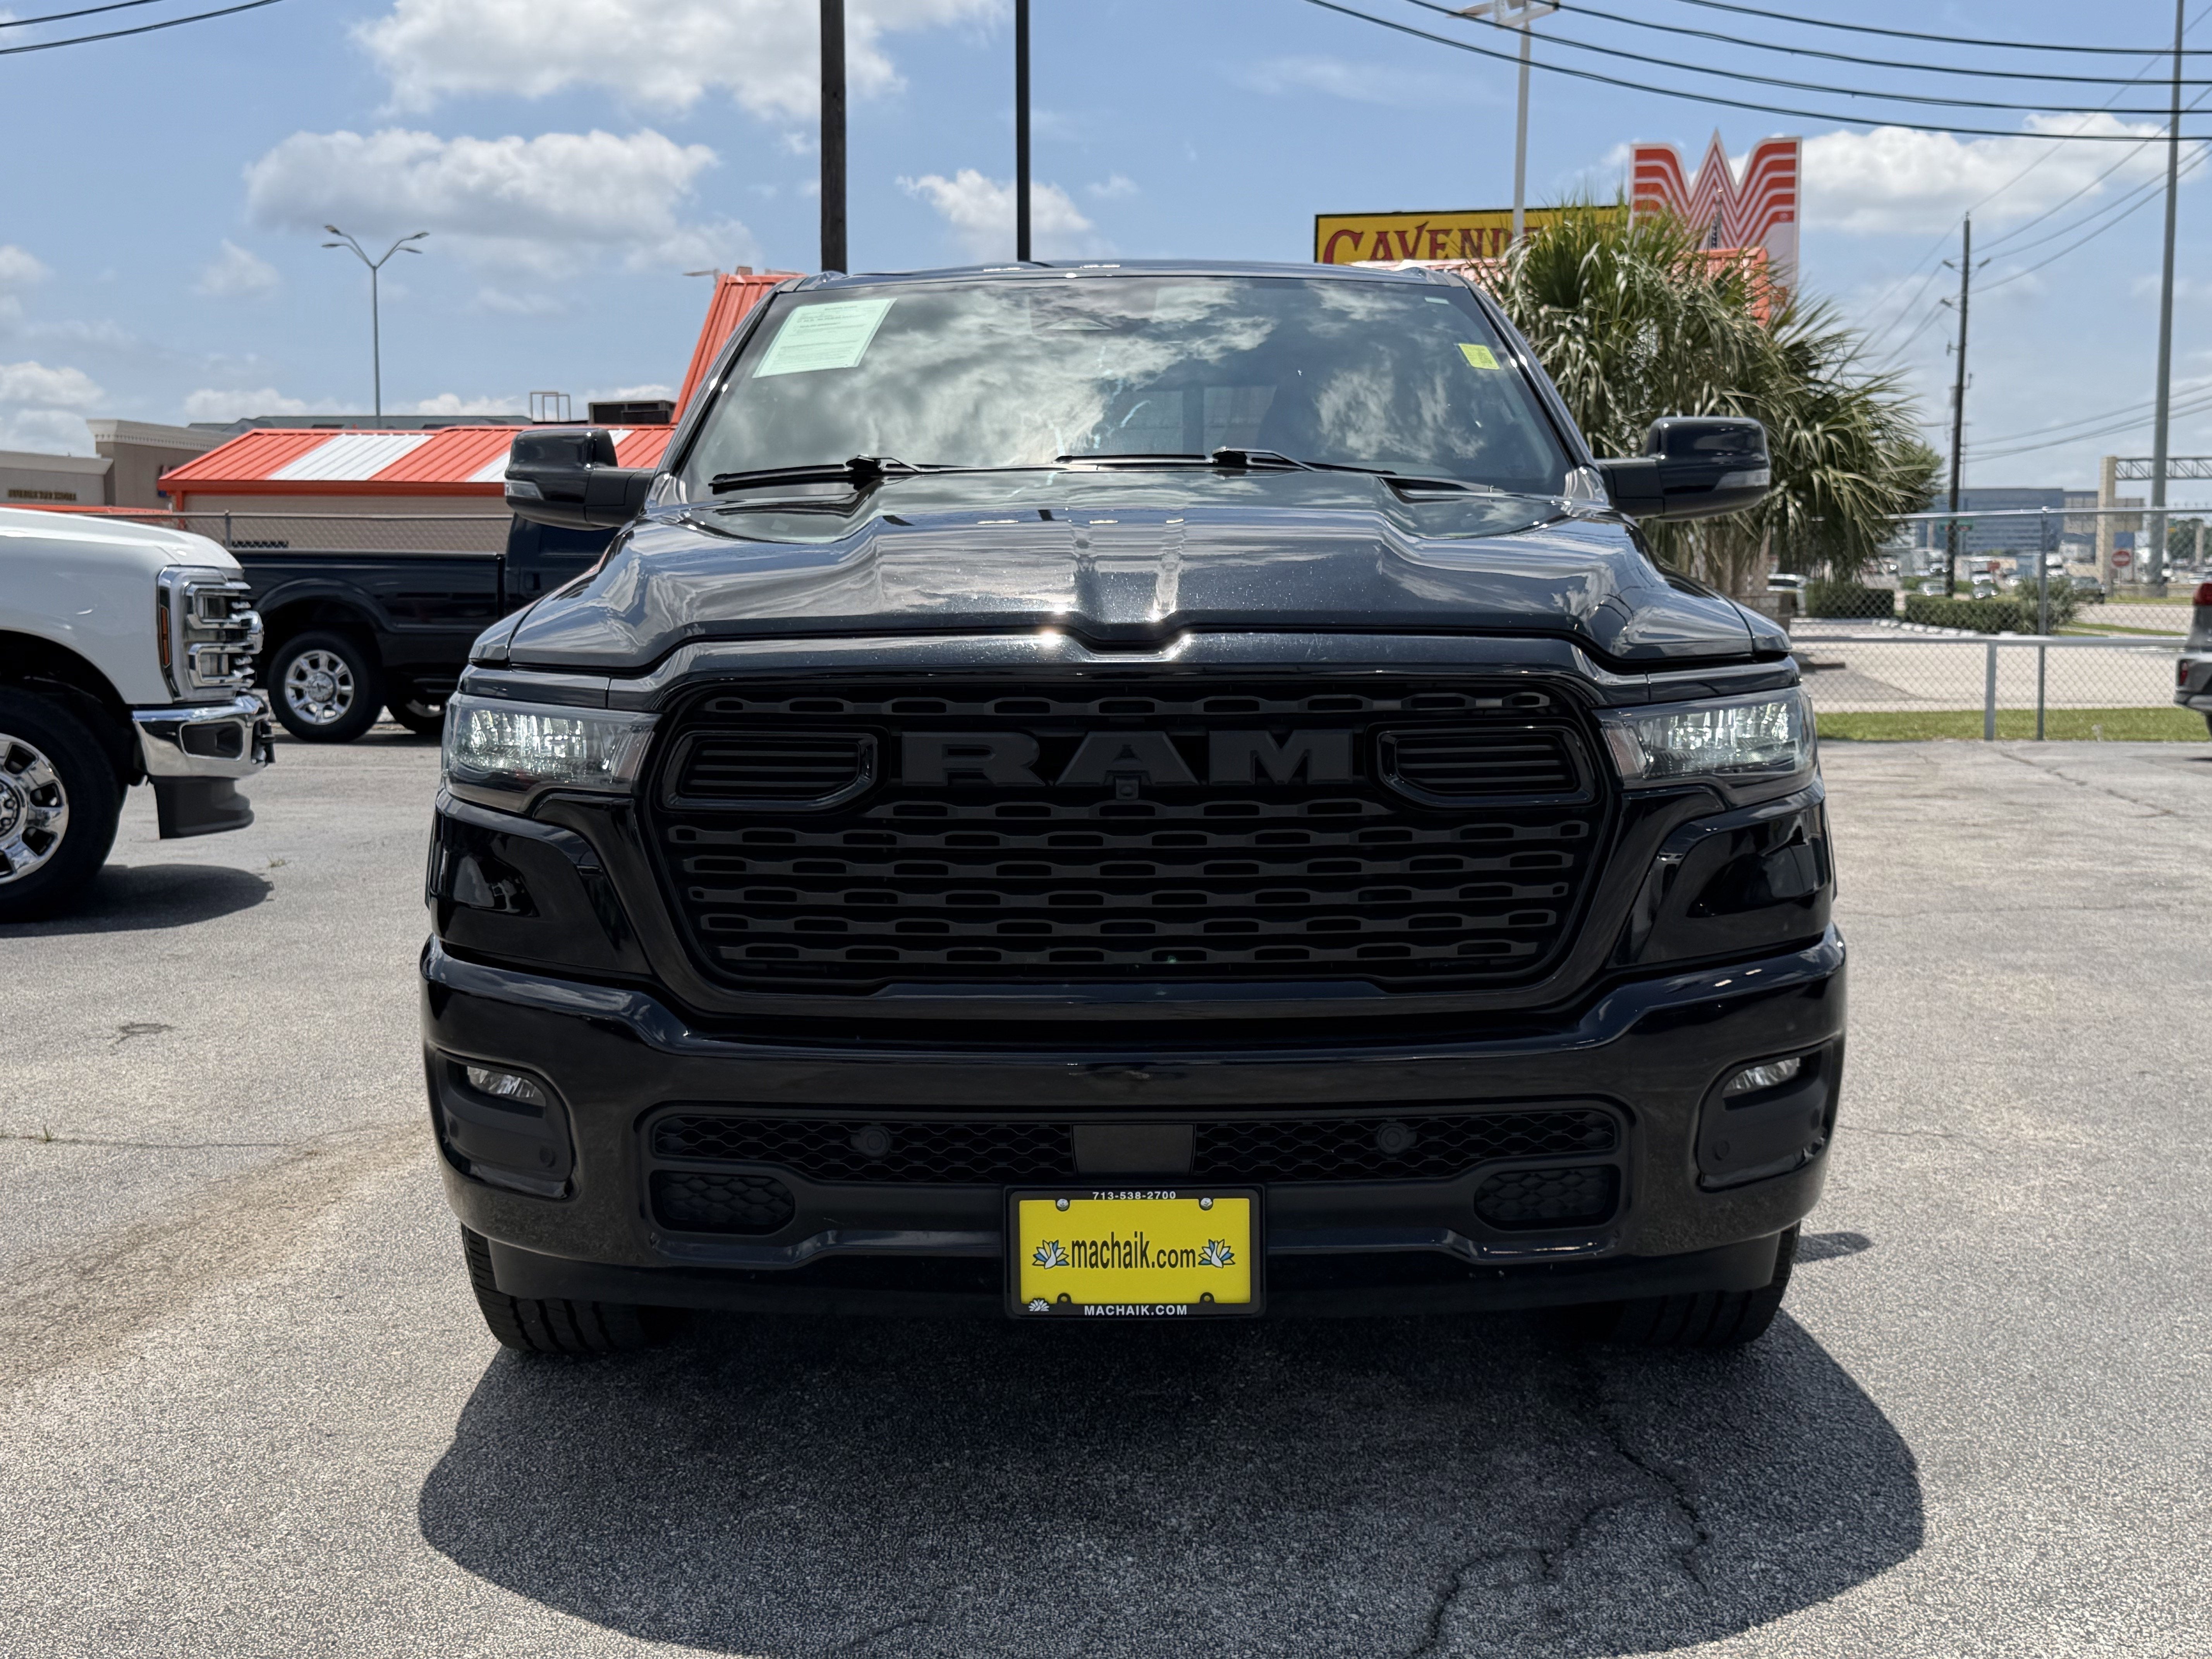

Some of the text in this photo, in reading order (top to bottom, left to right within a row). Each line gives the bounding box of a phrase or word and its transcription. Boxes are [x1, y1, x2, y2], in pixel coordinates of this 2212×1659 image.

[1322, 221, 1540, 264] CAVEND
[902, 730, 1354, 786] RAM
[1092, 1192, 1176, 1200] 713-538-2700
[1072, 1231, 1196, 1269] machaik.com
[1084, 1305, 1187, 1316] MACHAIK.COM
